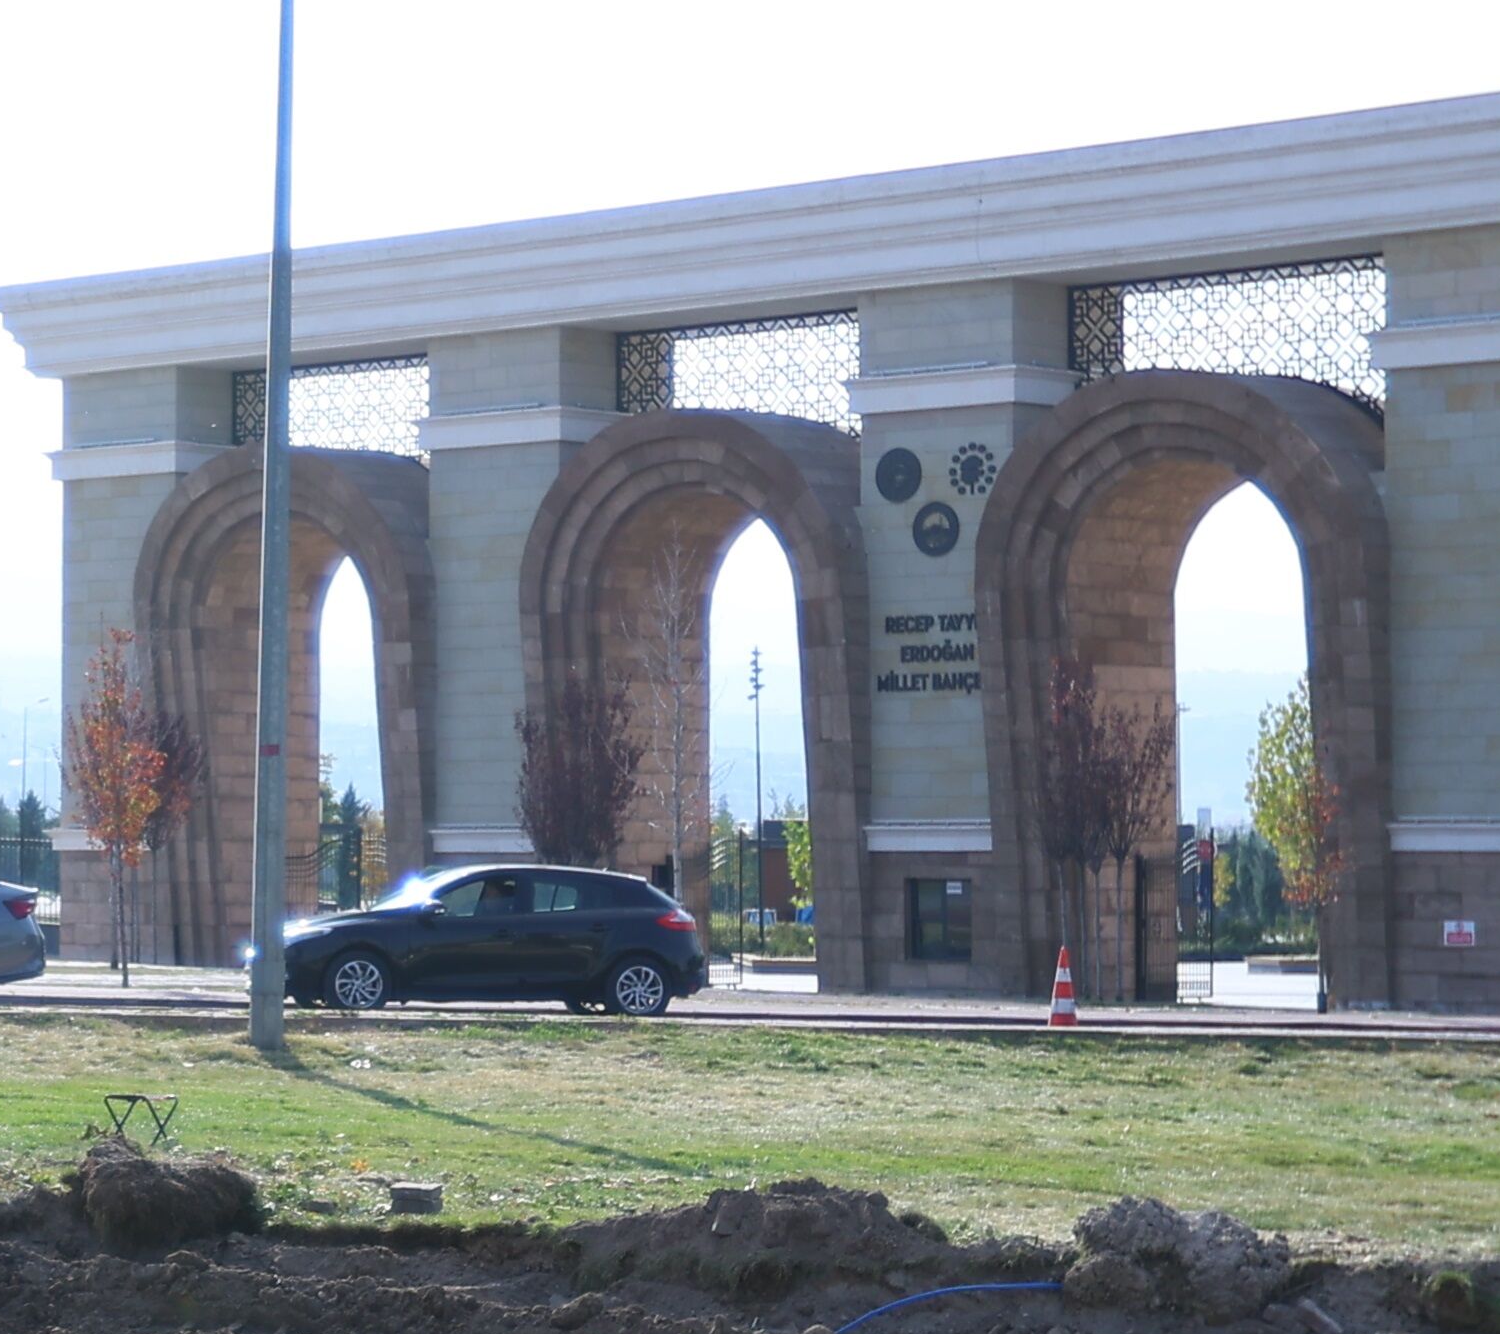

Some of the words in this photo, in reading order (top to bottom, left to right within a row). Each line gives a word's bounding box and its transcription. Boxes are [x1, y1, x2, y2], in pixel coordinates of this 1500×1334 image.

[885, 614, 935, 635] RECEP
[900, 639, 975, 663] ERDOĞAN
[877, 670, 929, 693] MİLLET
